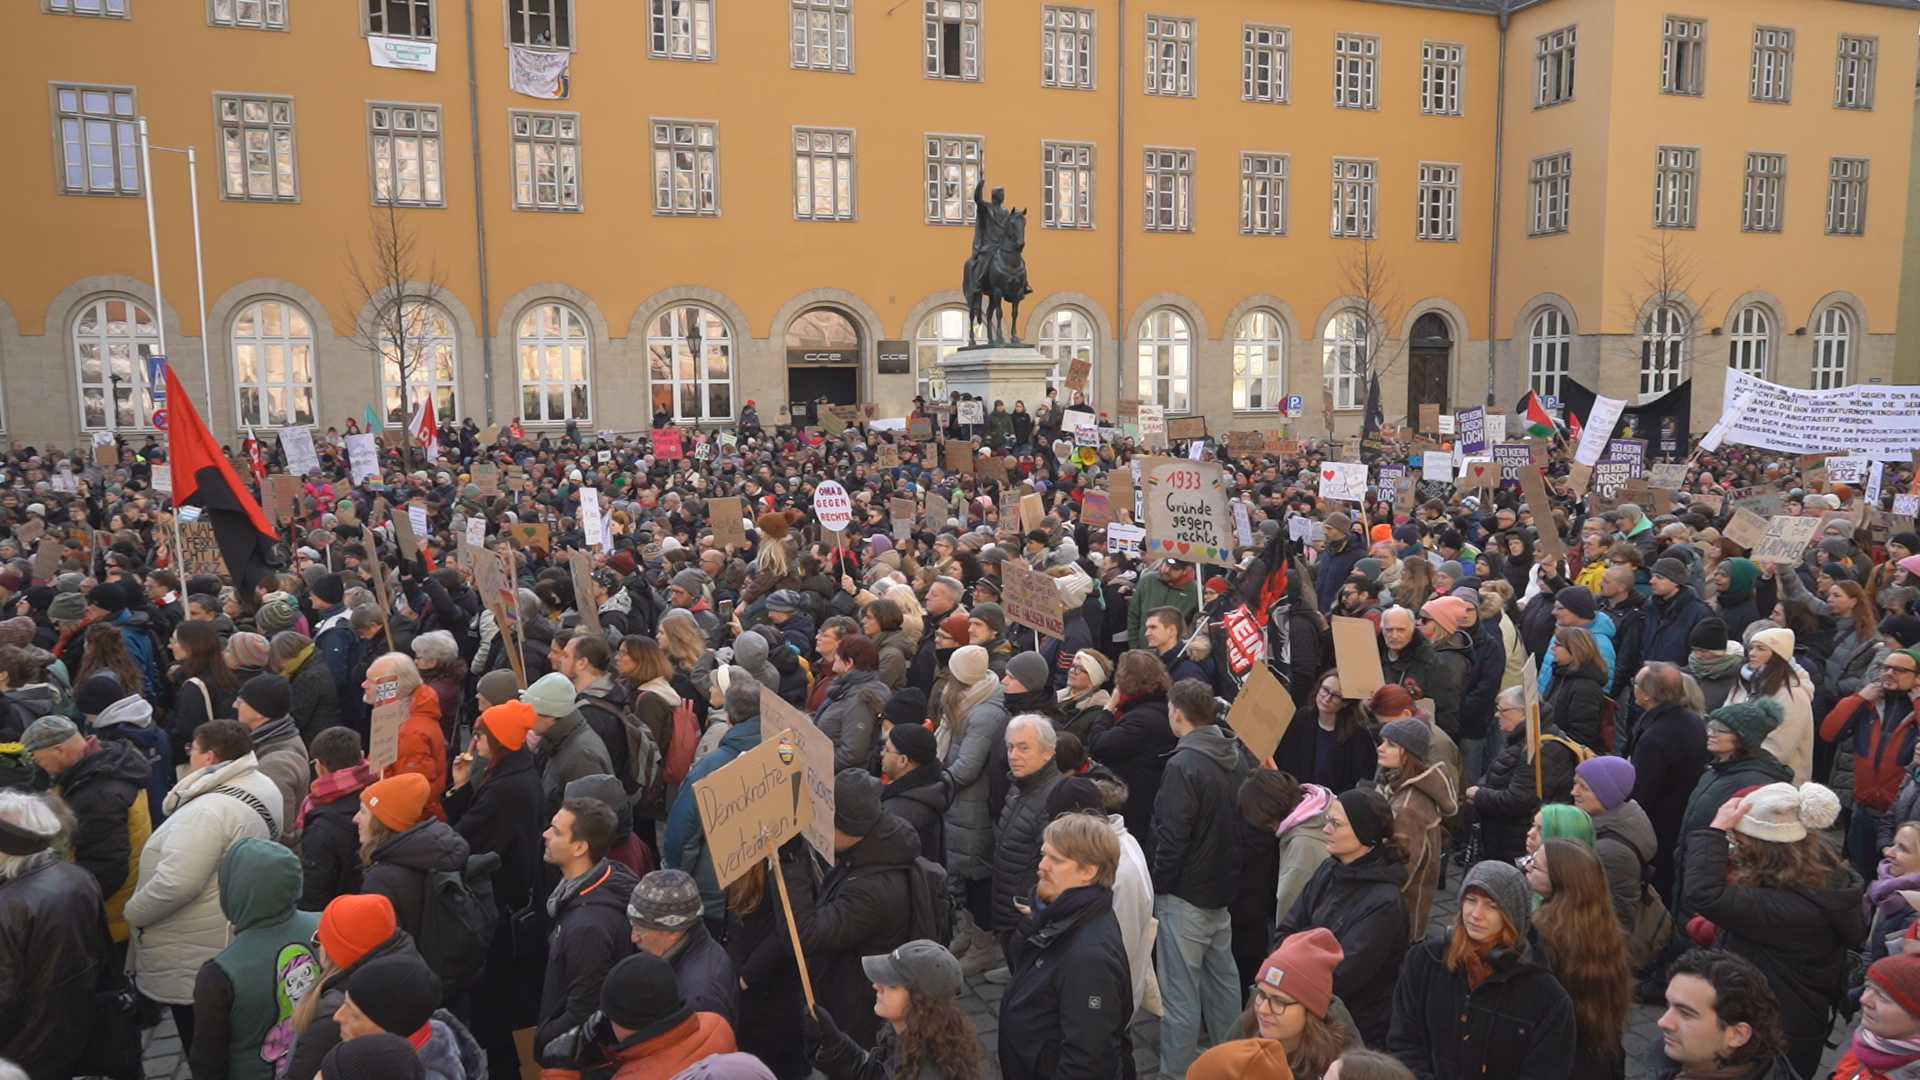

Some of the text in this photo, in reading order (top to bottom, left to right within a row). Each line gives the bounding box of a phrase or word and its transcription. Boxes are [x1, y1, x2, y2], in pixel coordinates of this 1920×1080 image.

[1860, 391, 1886, 399] GEGEN
[1290, 397, 1300, 409] P
[1461, 418, 1483, 433] ARSCH
[1462, 429, 1484, 445] LOCH
[1494, 447, 1529, 457] SEI KEIN
[1611, 443, 1641, 454] SEI KEIN
[1596, 464, 1610, 474] SEI
[1610, 463, 1630, 473] KEIN
[1165, 471, 1202, 490] 1933
[816, 499, 847, 508] GEGEN
[1166, 492, 1213, 517] Gründe
[819, 512, 850, 522] RECHTS
[1172, 515, 1213, 531] gegen
[1176, 531, 1218, 546] rechts
[698, 762, 787, 835] Demokratie
